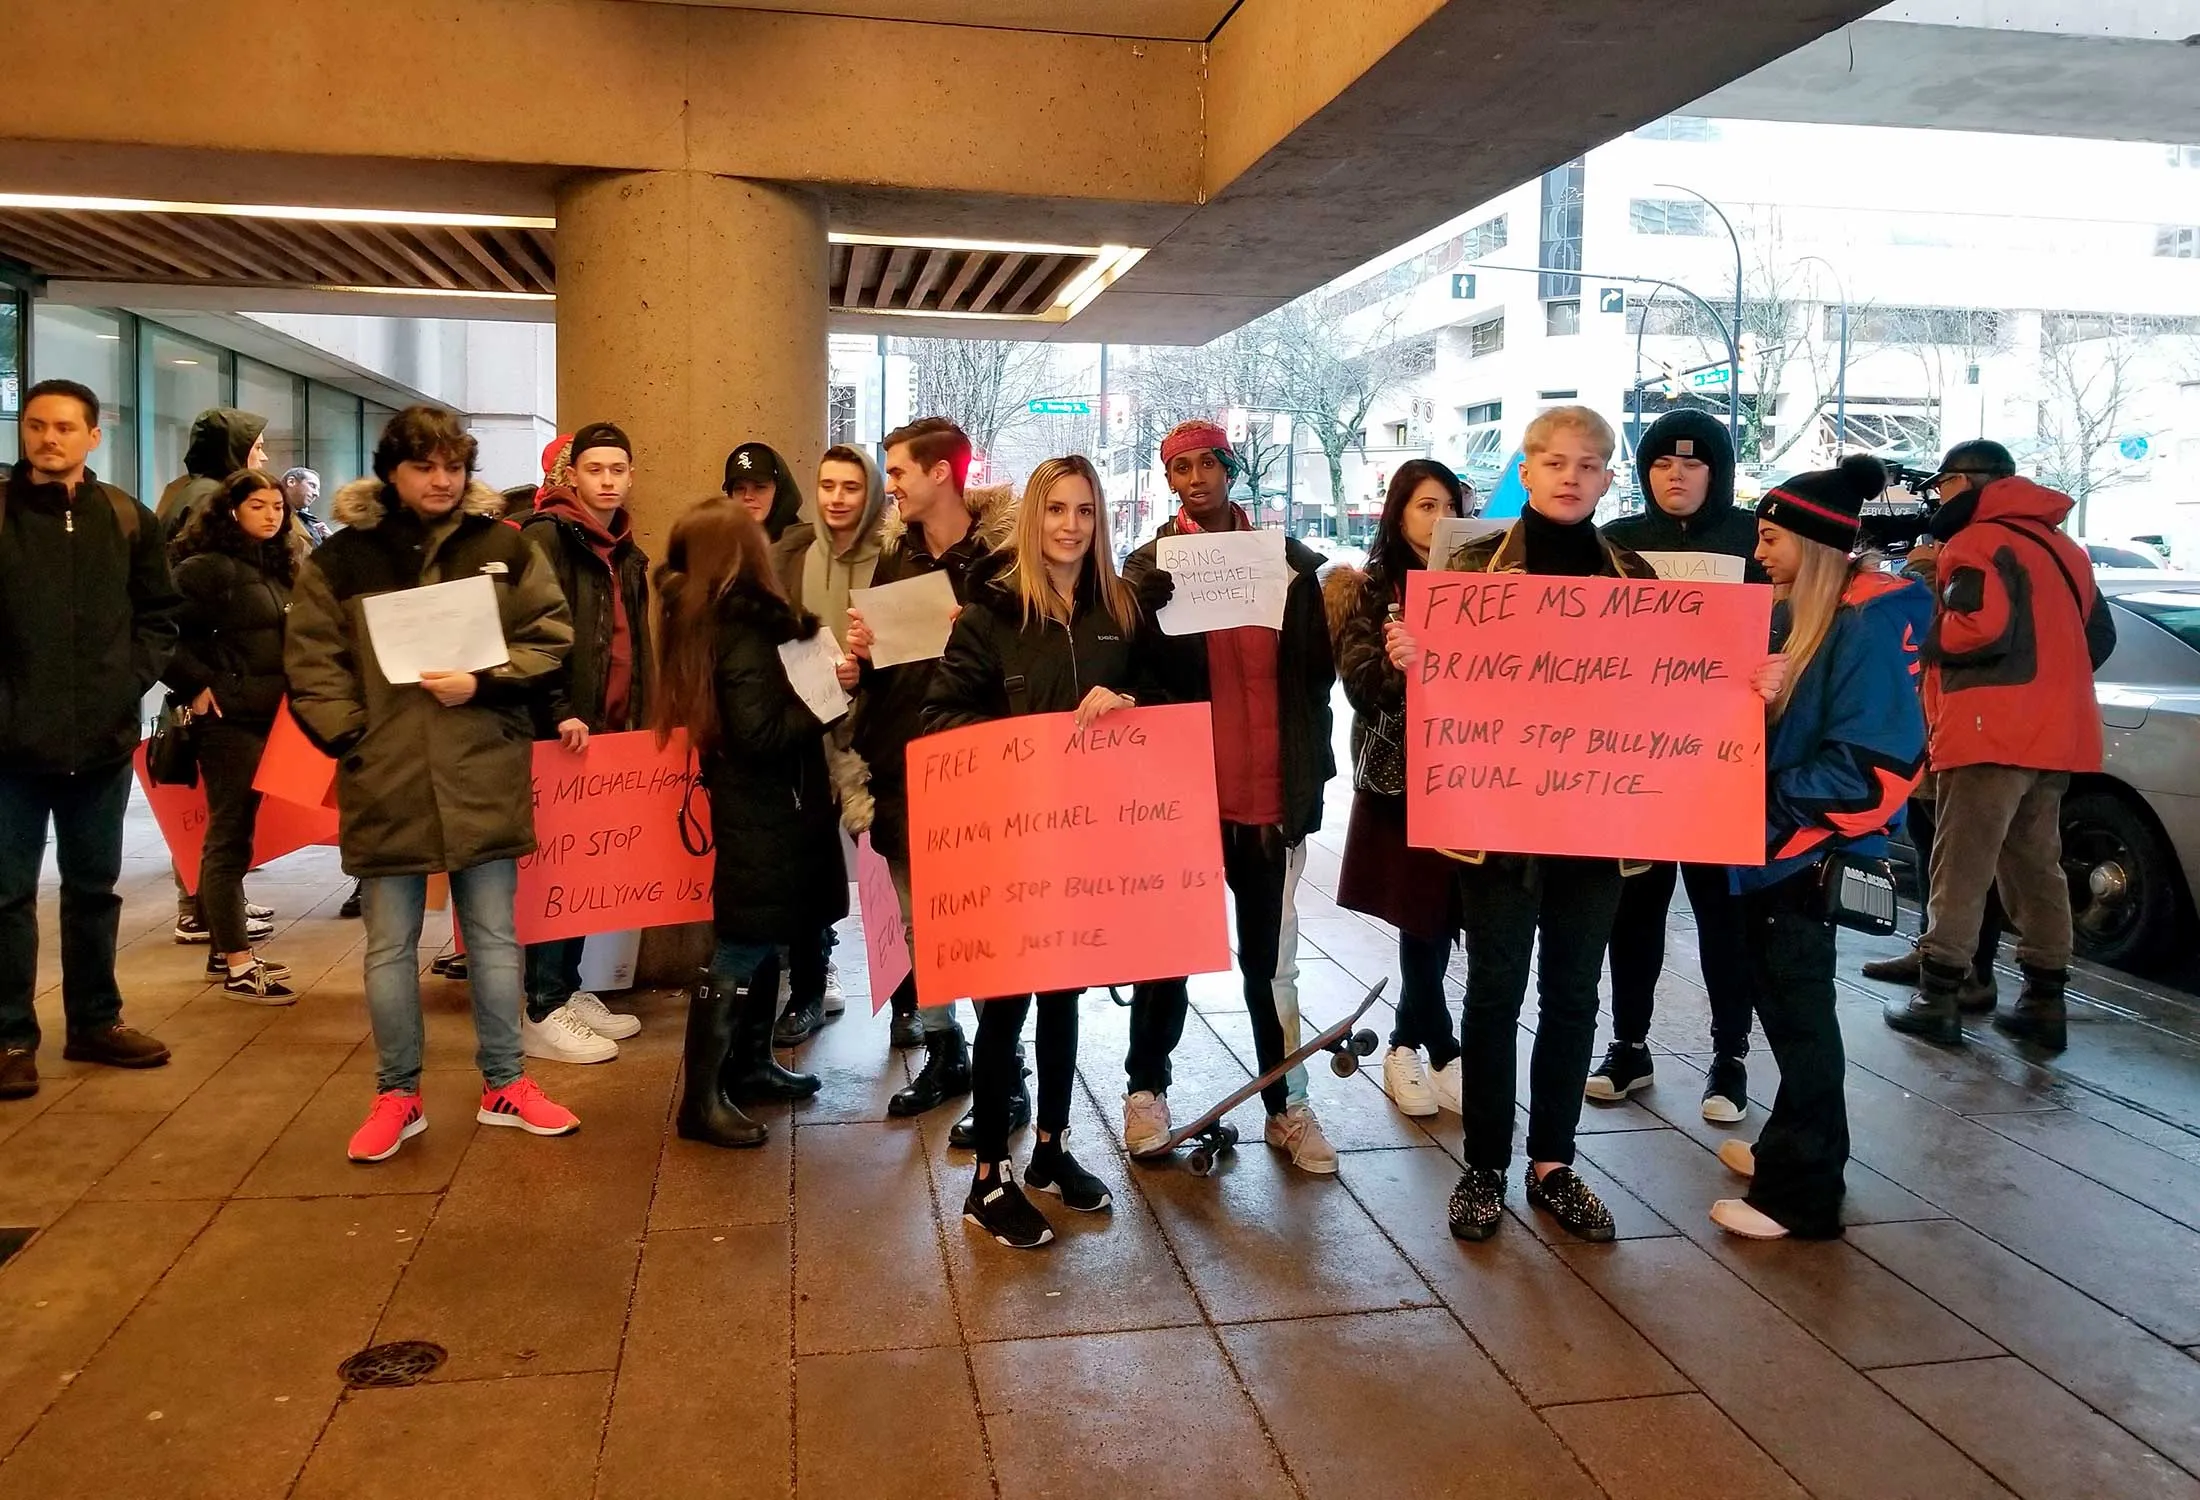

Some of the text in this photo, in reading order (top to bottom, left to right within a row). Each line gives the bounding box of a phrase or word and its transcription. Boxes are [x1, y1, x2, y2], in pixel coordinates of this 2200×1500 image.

[1164, 548, 1226, 569] BRING
[1181, 566, 1262, 586] MICHAEL
[1653, 559, 1728, 579] QUAL
[1191, 585, 1256, 605] HOME!!
[1423, 583, 1704, 630] FREE MS MENG
[1422, 650, 1729, 686] BRING MICHAEL HOME
[1423, 717, 1504, 748] TRUMP
[1520, 724, 1576, 749] STOP
[1586, 729, 1704, 760] BULLYING
[924, 725, 1147, 792] FREE MS MENG
[553, 770, 647, 805] MICHAEL
[1426, 764, 1662, 797] EQUAL JUSTICE
[585, 825, 641, 857] STOP
[927, 800, 1184, 852] BRING MICHAEL HOME
[544, 881, 664, 919] BULLYING
[929, 885, 992, 920] TRUMP
[1005, 880, 1051, 903] STOP
[1065, 874, 1165, 898] BULLYING
[937, 928, 1109, 970] EQUAL JUSTICE
